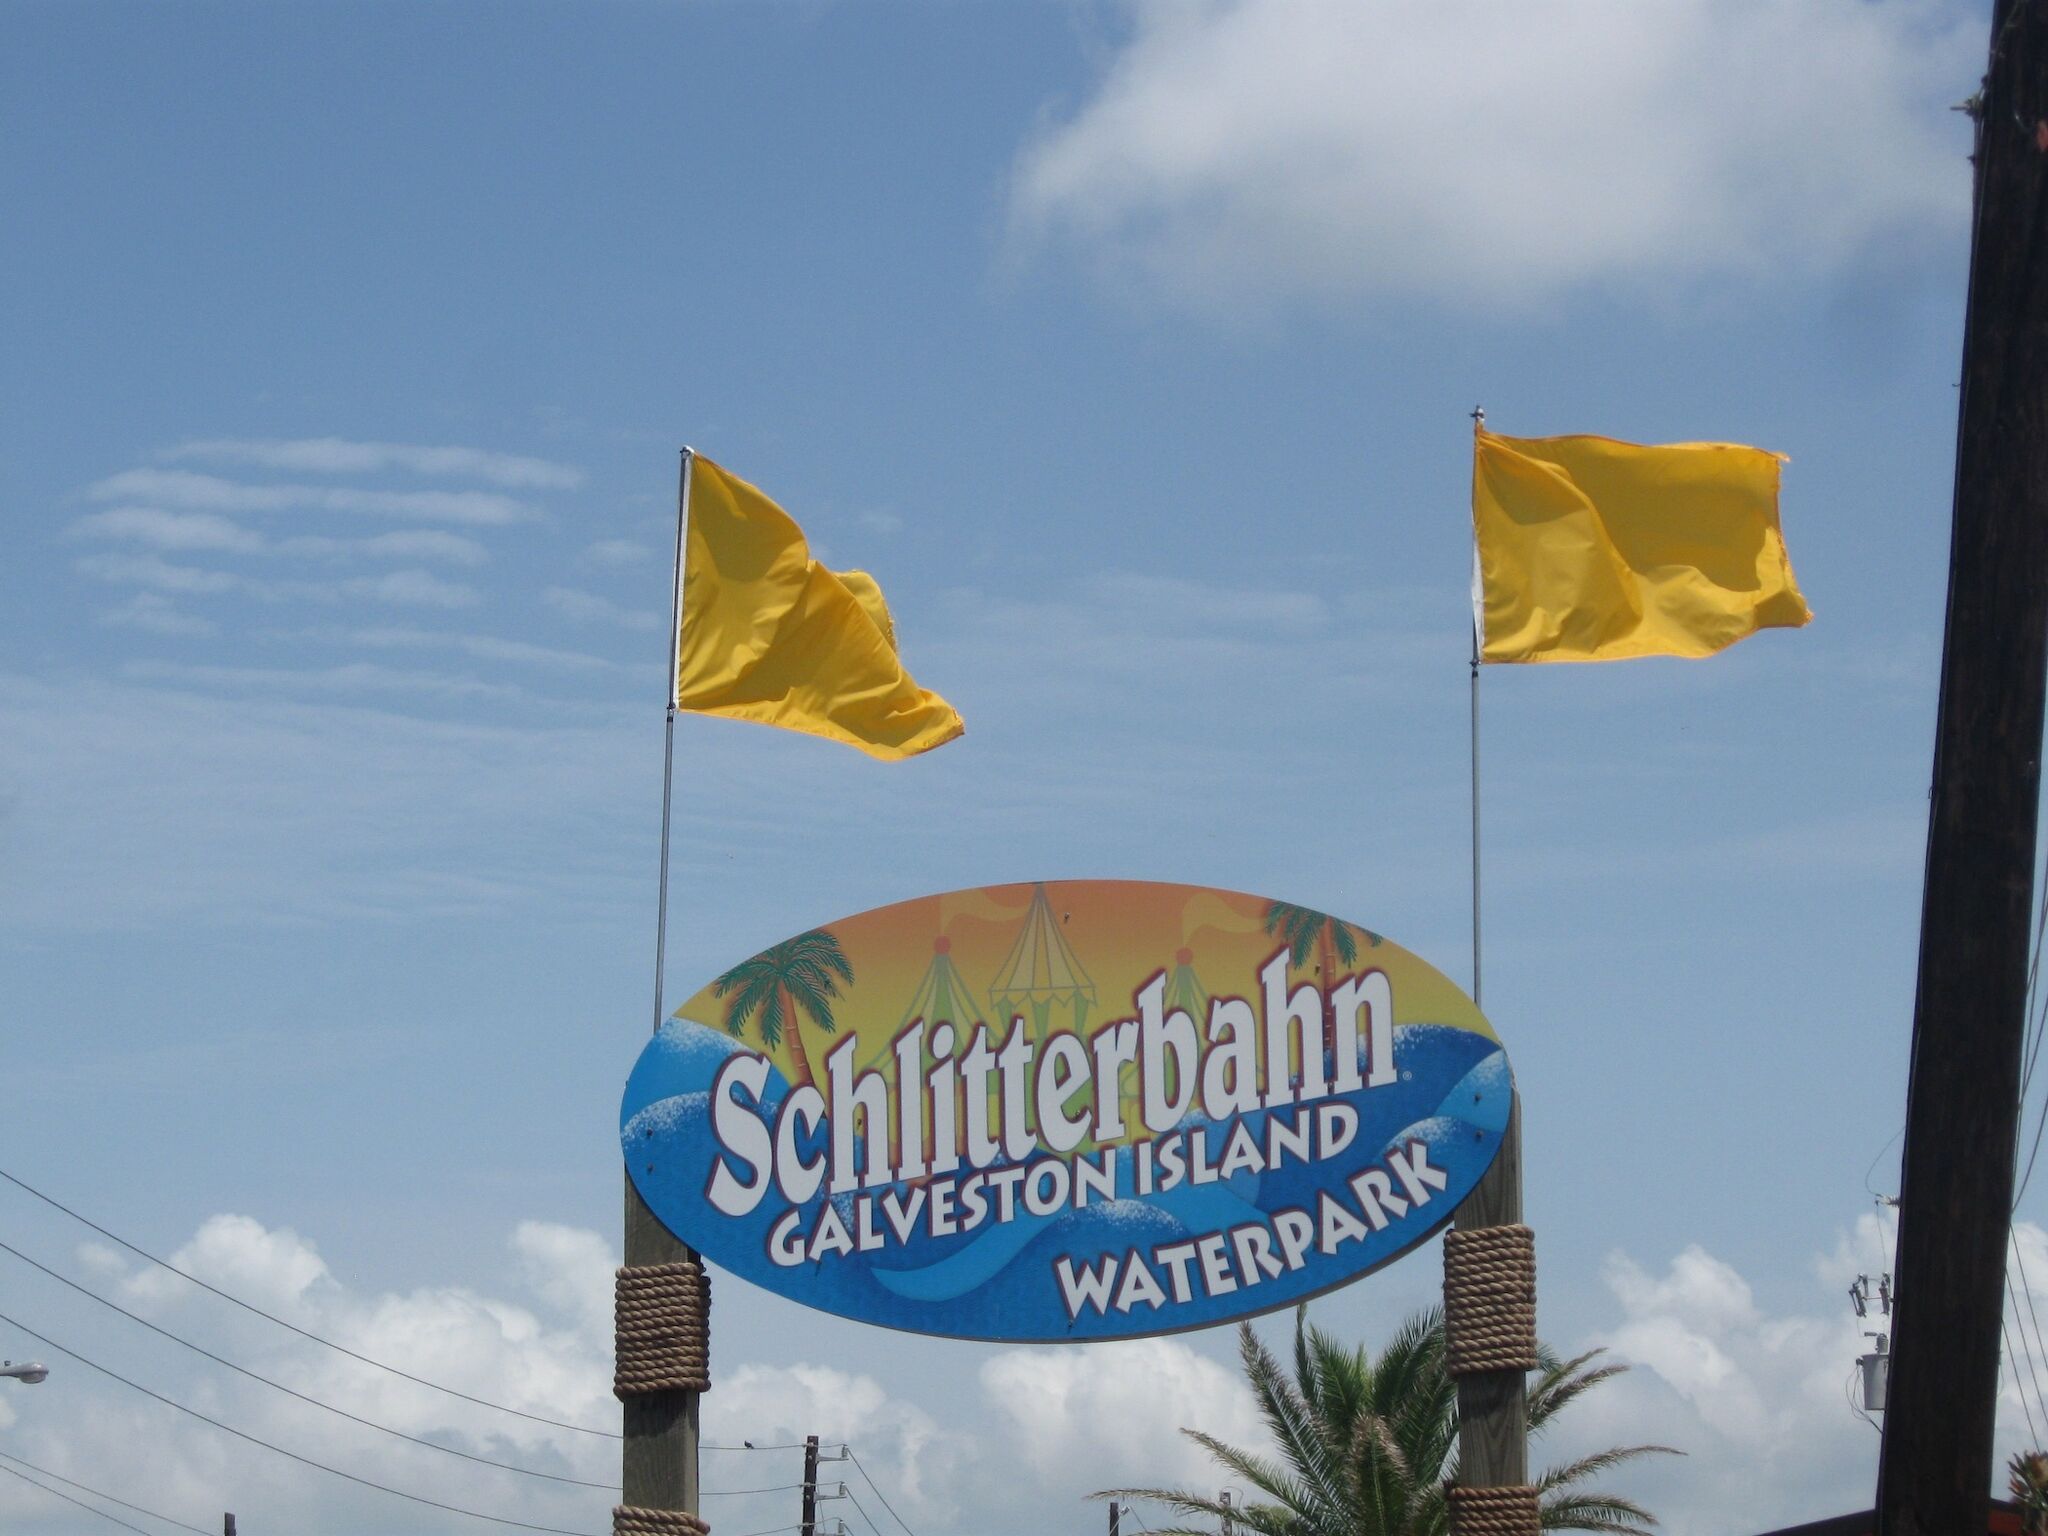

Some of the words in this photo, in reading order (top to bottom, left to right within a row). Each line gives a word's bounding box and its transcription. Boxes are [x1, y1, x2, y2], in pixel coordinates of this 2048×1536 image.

[706, 944, 1397, 1217] Schlitterbahn
[768, 1147, 1116, 1267] GALVESTON
[1136, 1103, 1359, 1196] ISLAND
[1055, 1138, 1447, 1319] WATERPARK
